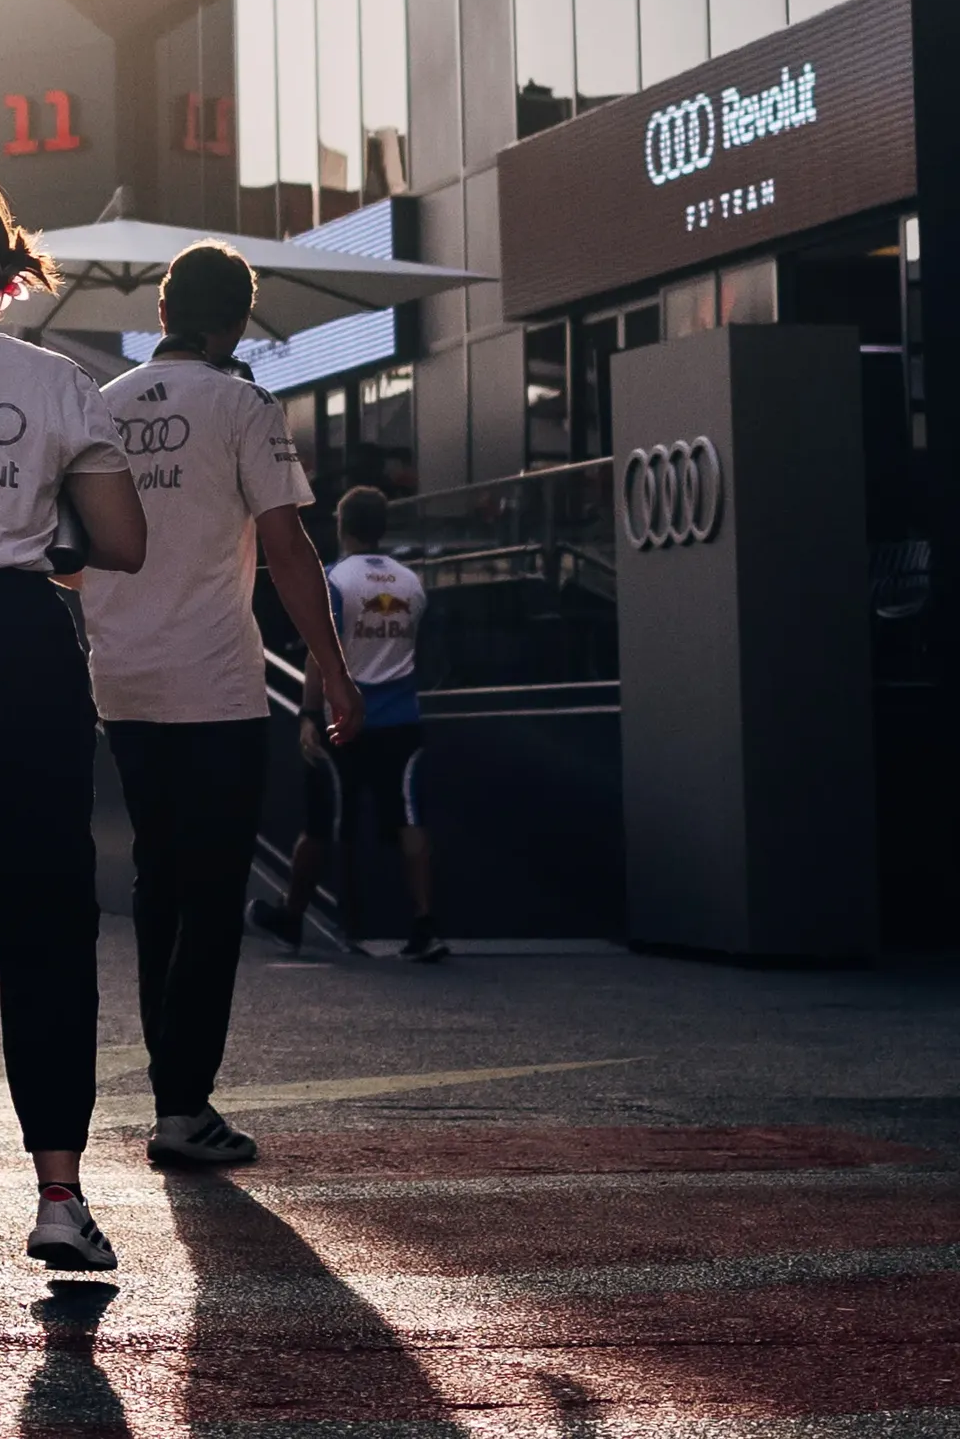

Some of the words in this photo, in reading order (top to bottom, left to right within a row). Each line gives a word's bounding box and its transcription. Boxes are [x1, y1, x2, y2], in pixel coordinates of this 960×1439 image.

[3, 89, 81, 156] 11
[721, 62, 817, 149] Revolut
[720, 178, 775, 218] TEAM
